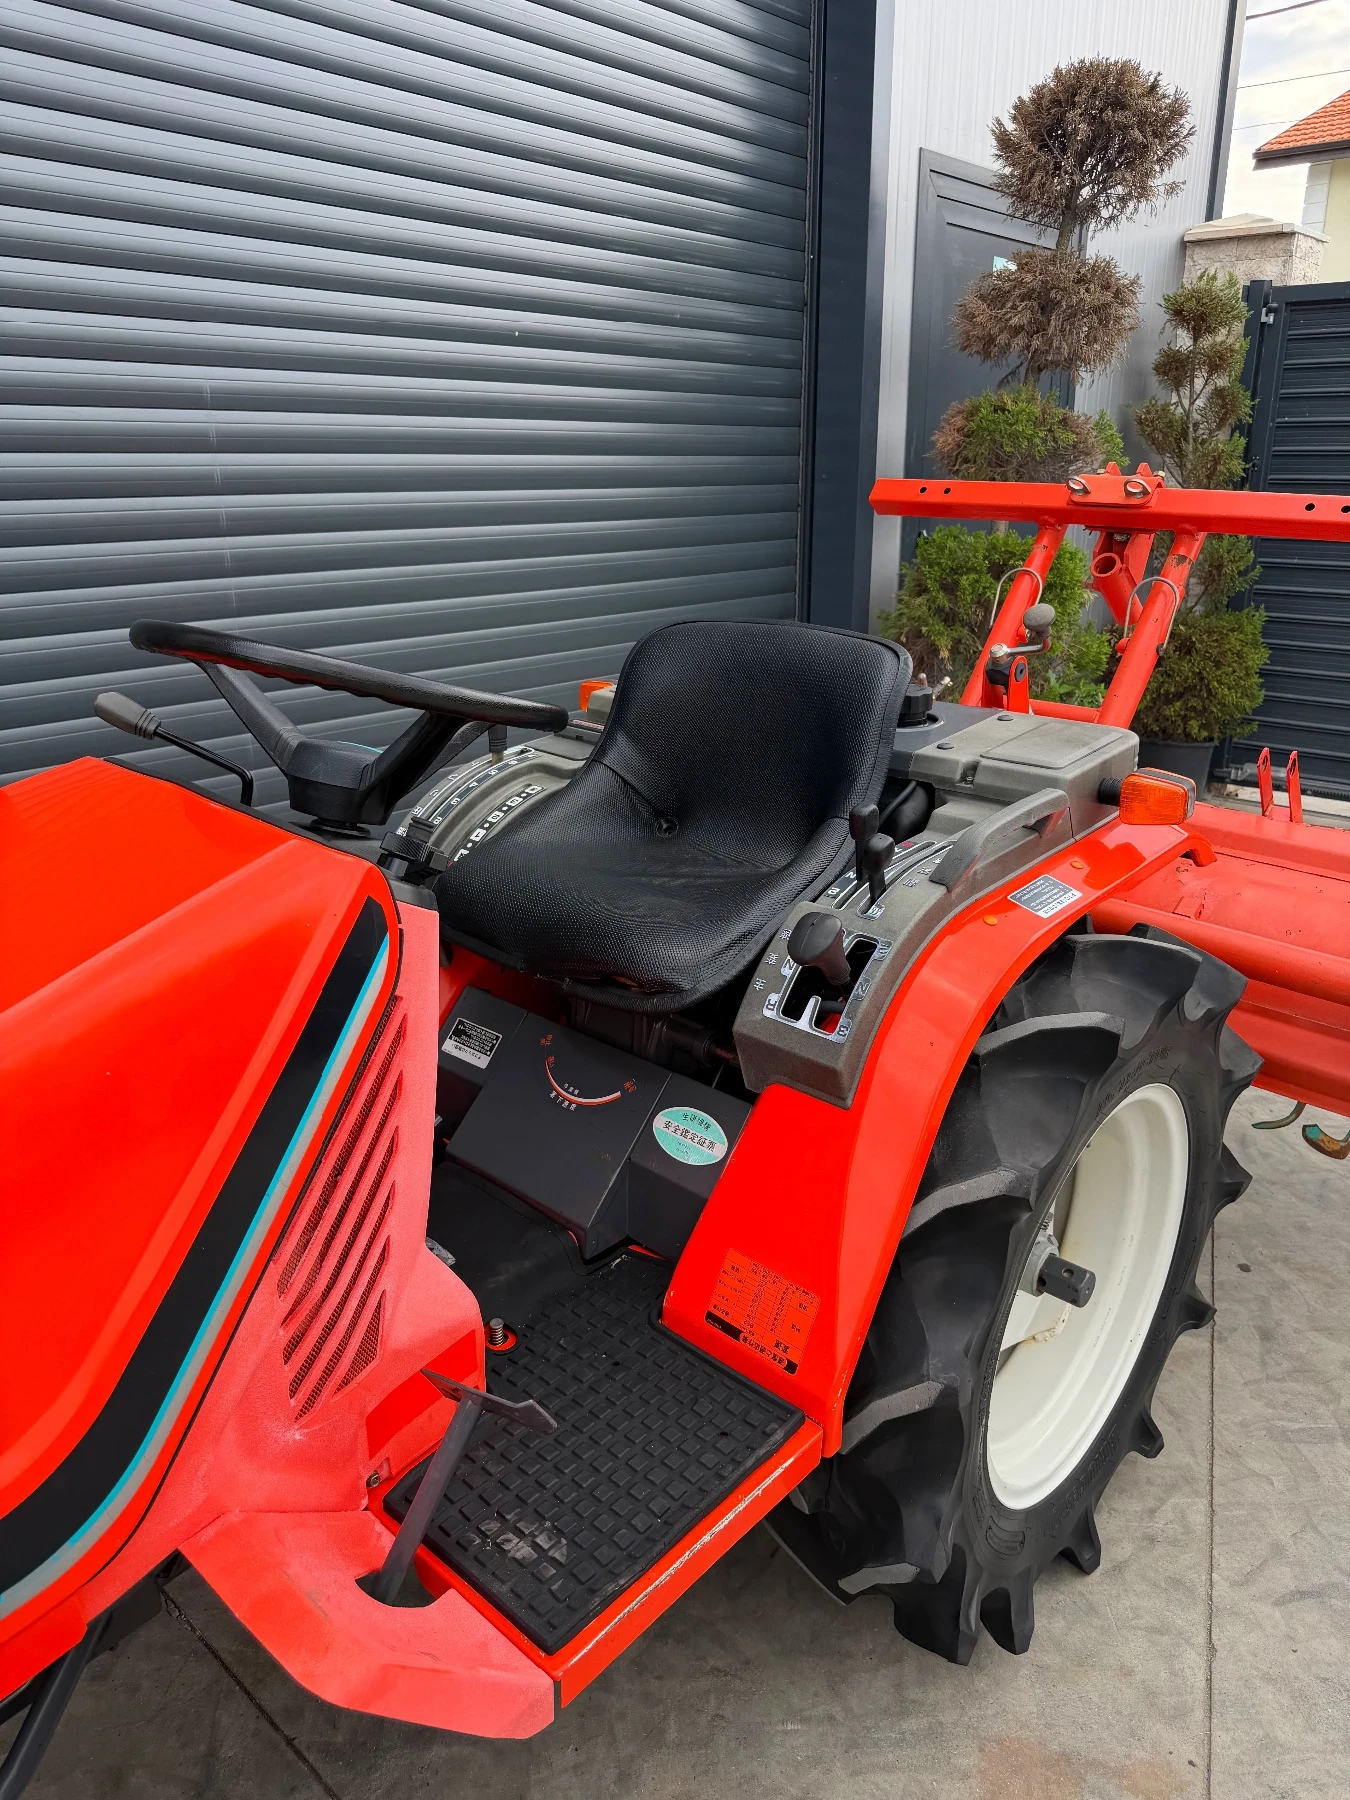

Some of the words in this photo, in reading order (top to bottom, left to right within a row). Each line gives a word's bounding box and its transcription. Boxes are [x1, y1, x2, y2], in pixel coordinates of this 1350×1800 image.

[662, 1120, 718, 1152] 安全鑑定証票
